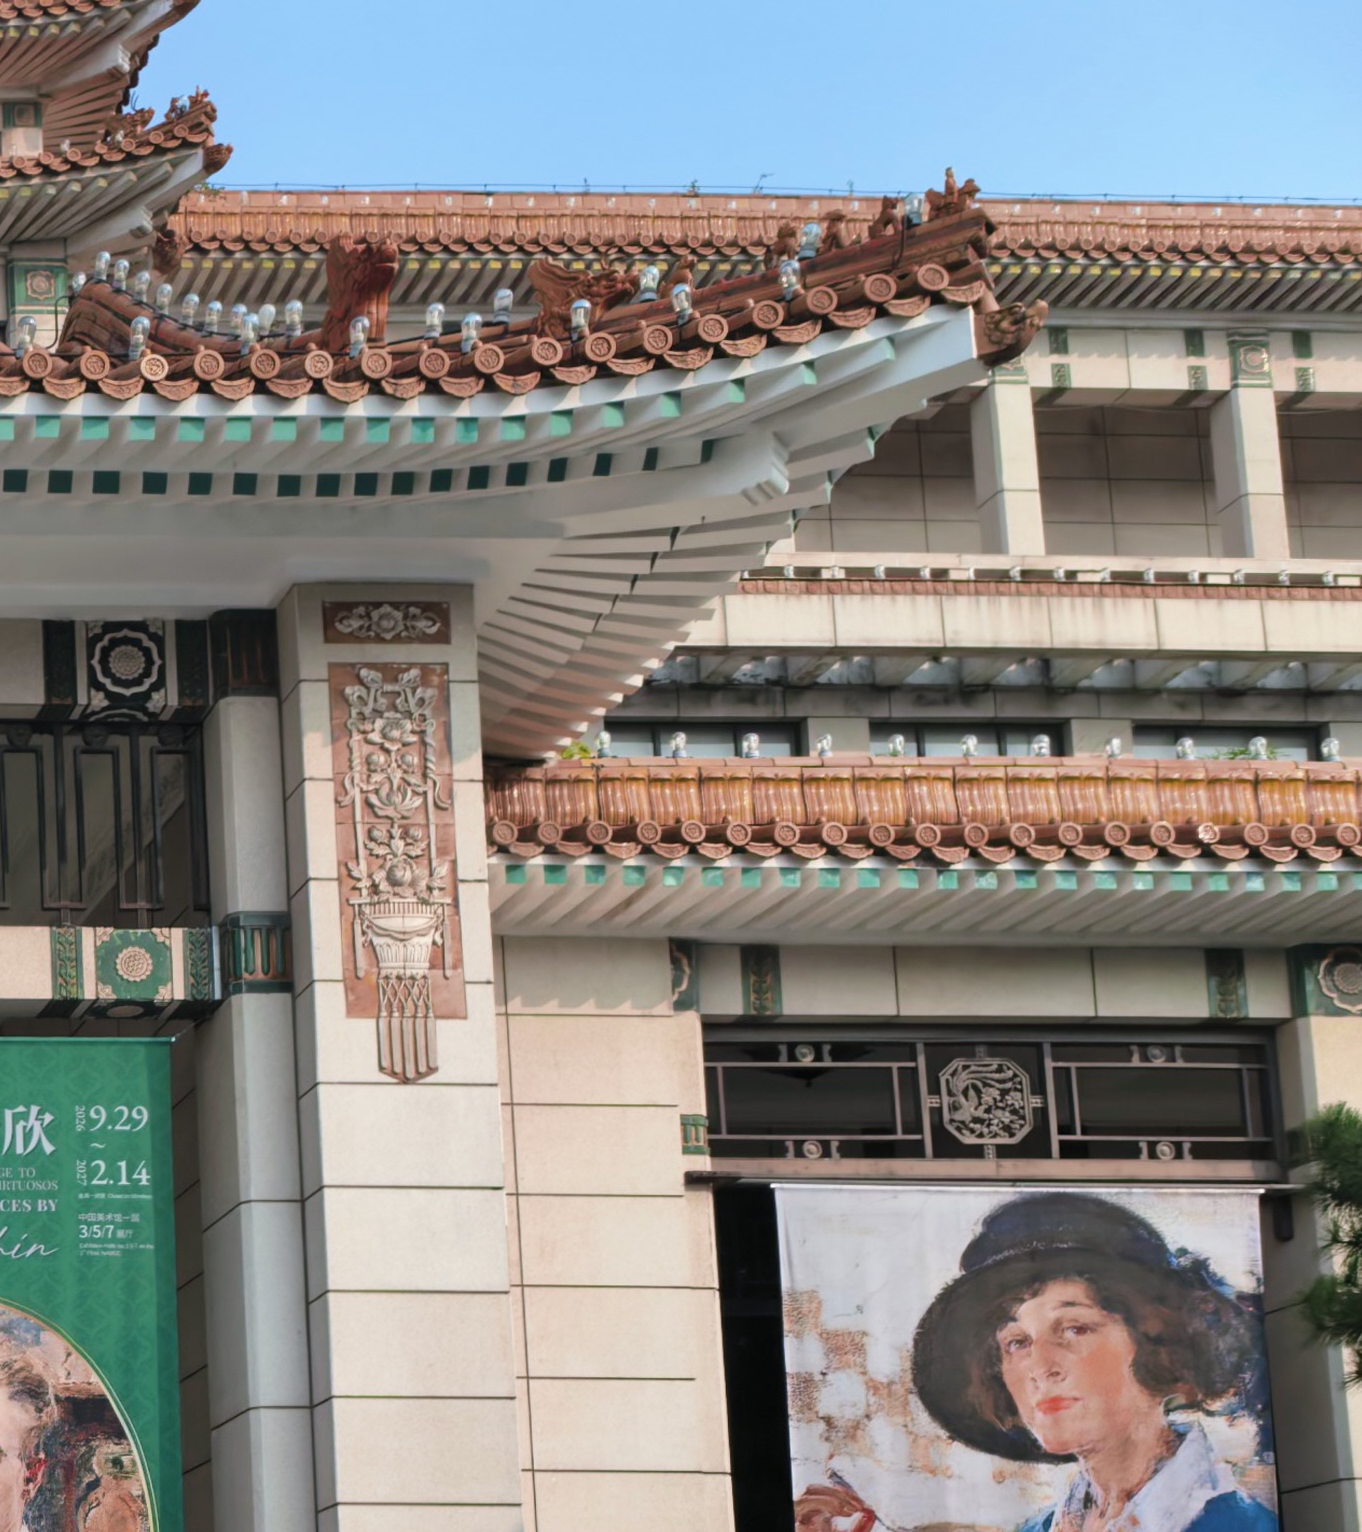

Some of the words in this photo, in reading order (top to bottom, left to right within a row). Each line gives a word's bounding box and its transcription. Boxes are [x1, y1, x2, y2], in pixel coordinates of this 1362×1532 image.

[89, 1105, 148, 1131] 9.29
[19, 1167, 36, 1178] TO
[91, 1160, 151, 1185] 2.14
[37, 1199, 58, 1212] BY
[79, 1225, 115, 1238] 3/5/7
